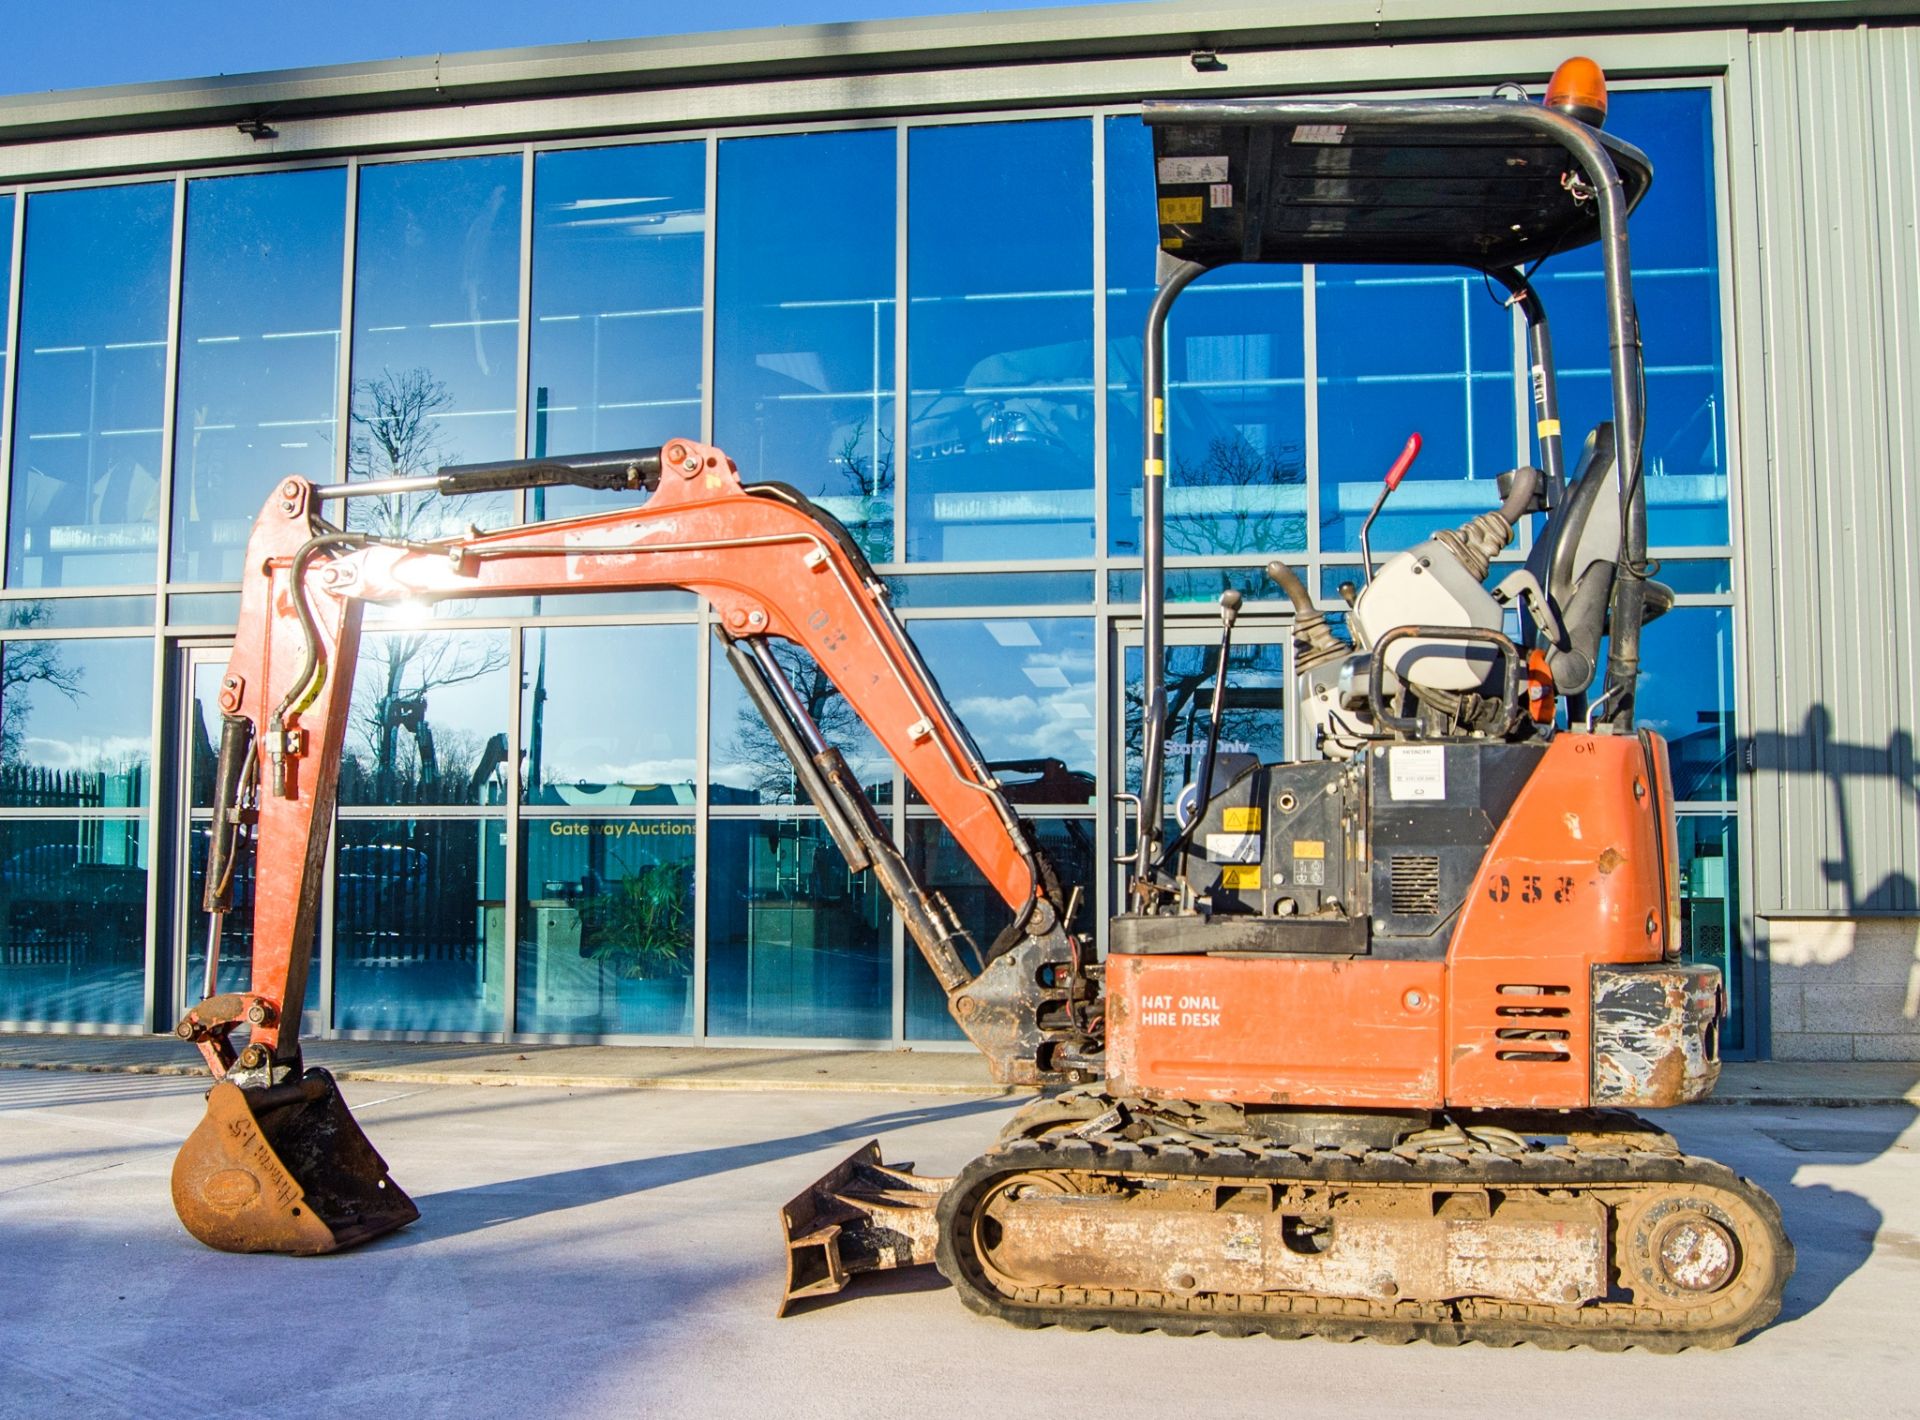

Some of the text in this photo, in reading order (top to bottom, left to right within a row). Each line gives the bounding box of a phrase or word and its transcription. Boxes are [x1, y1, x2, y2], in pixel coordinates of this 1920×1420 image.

[550, 821, 624, 839] Gateway
[1141, 1012, 1221, 1027] HIRE DESK
